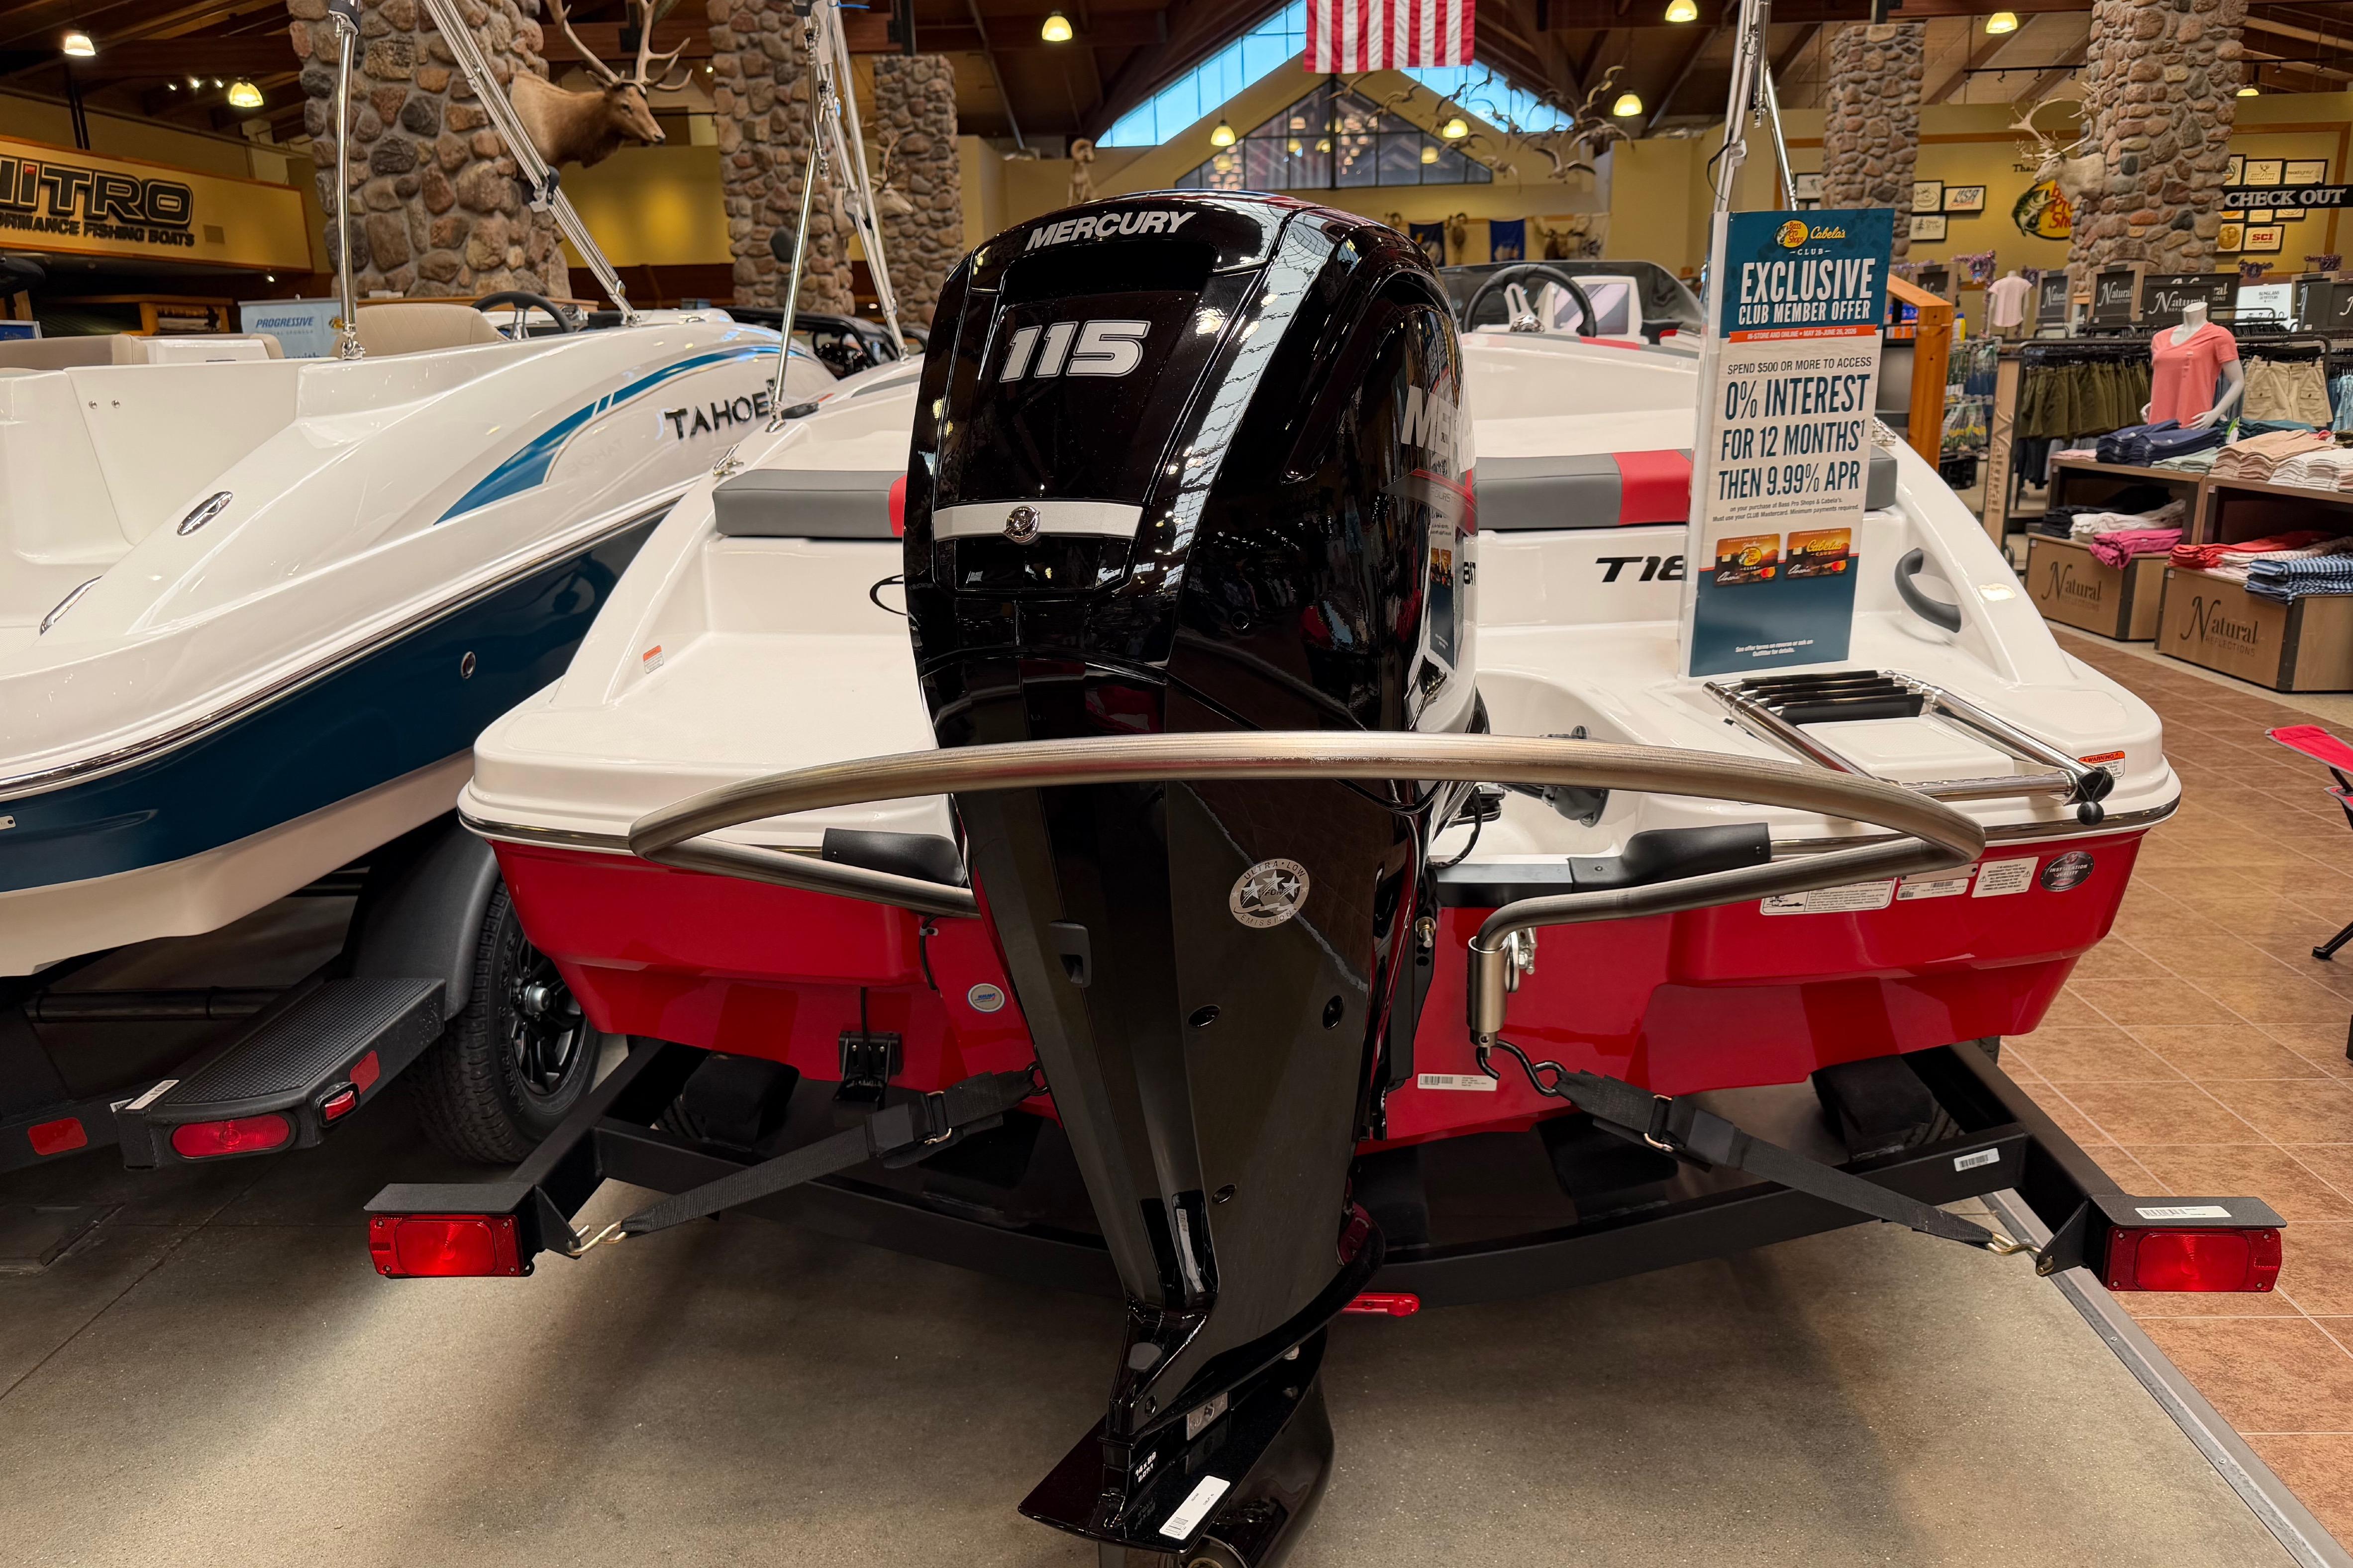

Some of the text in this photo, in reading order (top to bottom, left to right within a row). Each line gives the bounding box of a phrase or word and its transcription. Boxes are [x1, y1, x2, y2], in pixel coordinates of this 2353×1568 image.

[2225, 189, 2347, 207] CHECK OUT
[83, 222, 145, 241] FISHING
[148, 229, 195, 247] BOATS
[1024, 211, 1196, 251] MERCURY
[1787, 236, 1804, 245] Shops
[1811, 226, 1846, 239] Cabela's
[1740, 258, 1875, 303] EXCLUSIVE
[2097, 282, 2134, 306] Natural
[256, 316, 314, 328] PROGRESSIVE
[1739, 300, 1871, 325] CLUB MEMBER OFFER
[999, 320, 1150, 383] 115
[1728, 357, 1872, 375] SPEND $500 OR MORE TO ACCESS
[1725, 374, 1871, 420] 0% INTEREST
[664, 392, 772, 440] TAHOE
[1721, 428, 1754, 461] FOR
[1760, 426, 1778, 458] 12
[1719, 461, 1860, 500] THEN 9.99% APR
[1748, 503, 1771, 511] purchase
[1813, 505, 1837, 514] payments
[2042, 561, 2102, 601] Natural
[2180, 596, 2258, 644] Natural
[2206, 636, 2255, 657] REFLECTIONS
[2088, 754, 2114, 763] WARNING
[1244, 861, 1306, 880] ULTRA LOW
[2050, 864, 2088, 873] INSTALLATION
[1240, 910, 1292, 926] EMISSION
